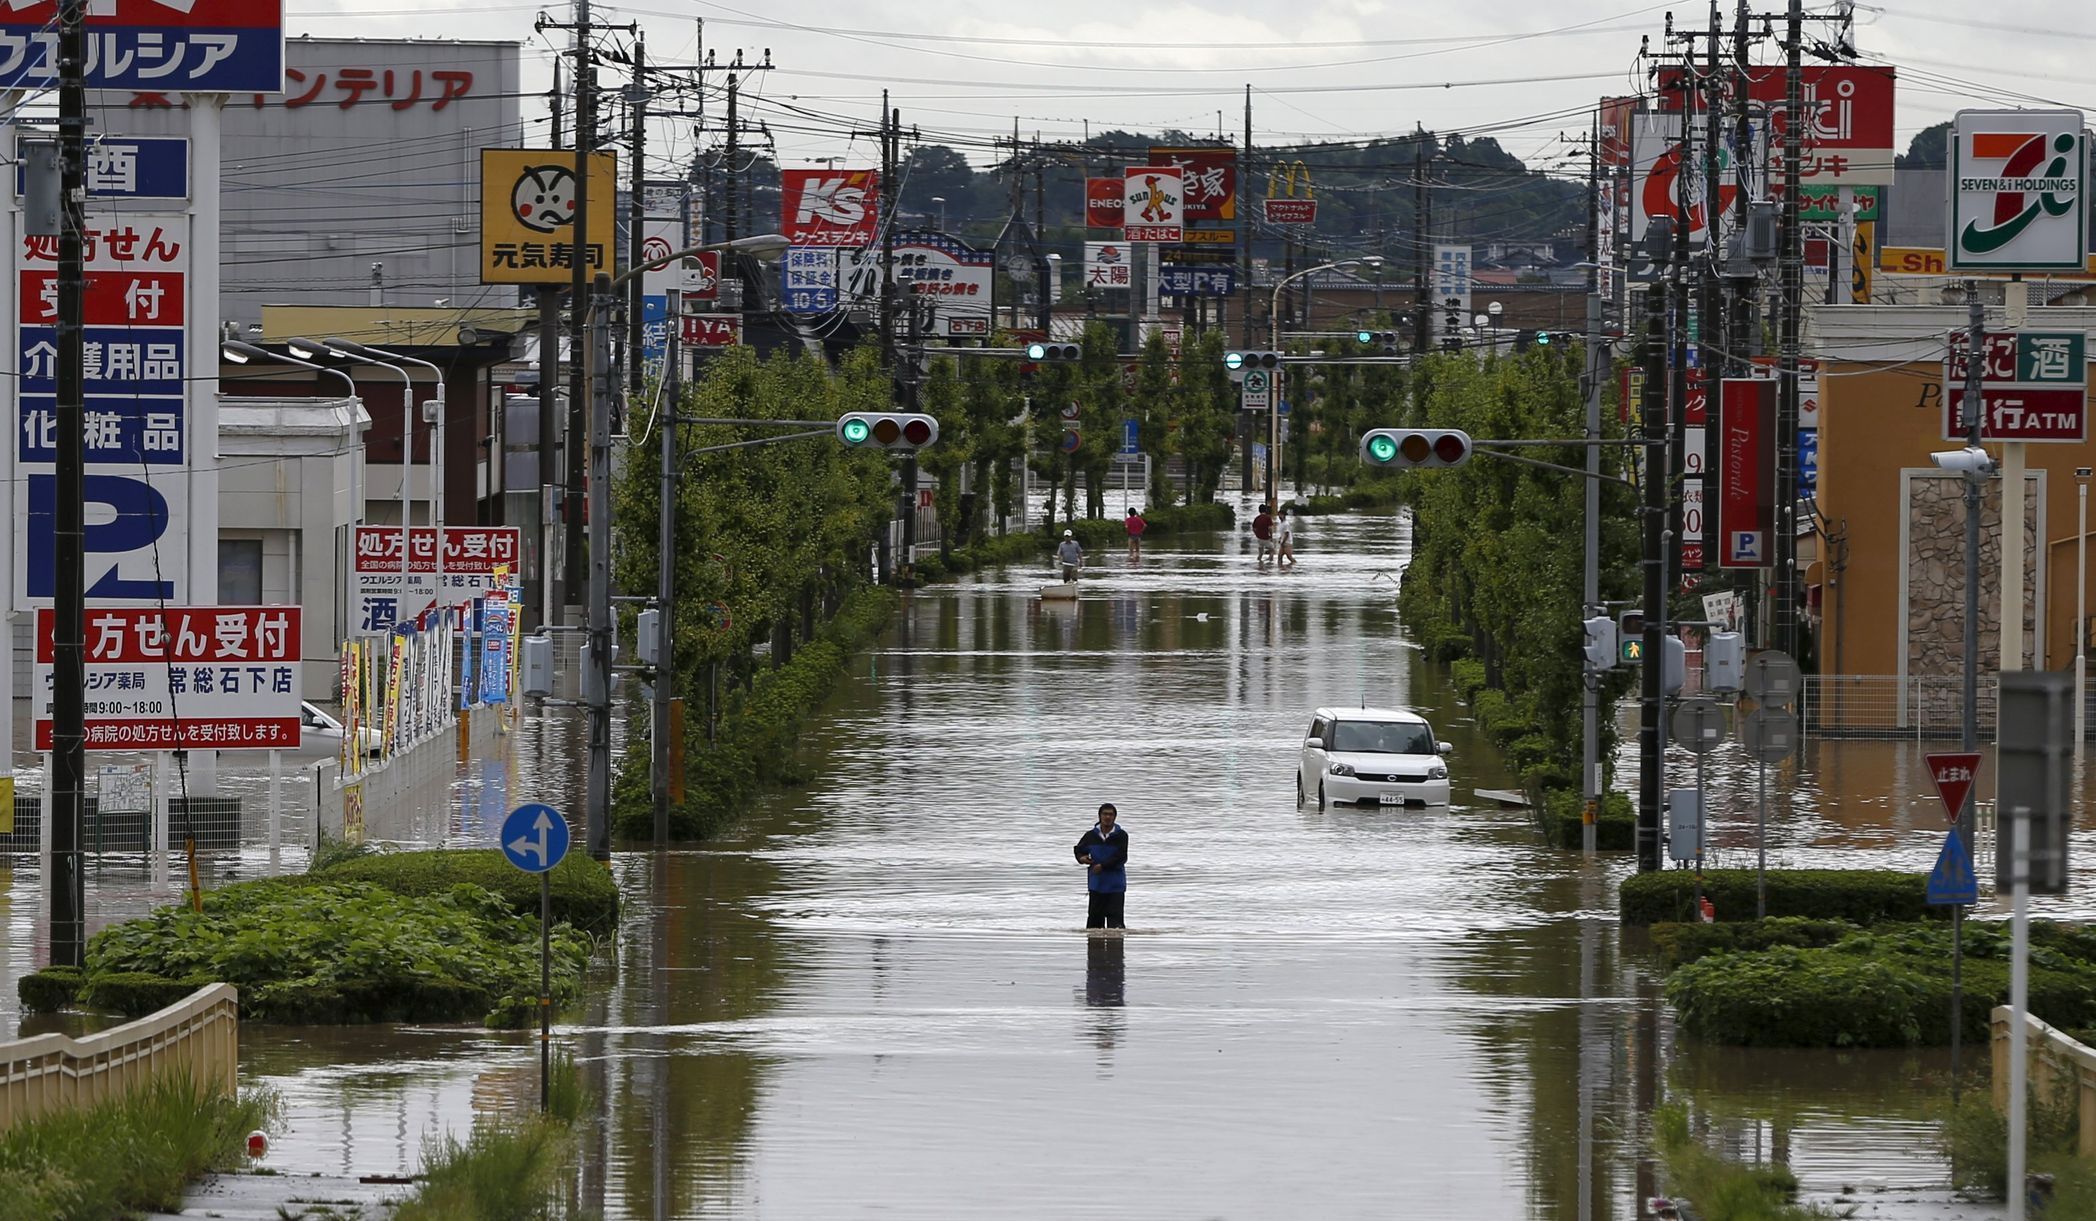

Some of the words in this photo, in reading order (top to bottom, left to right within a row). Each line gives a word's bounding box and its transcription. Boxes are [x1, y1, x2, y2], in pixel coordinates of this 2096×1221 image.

[2015, 178, 2076, 192] HOLDINGS
[1089, 199, 1125, 208] ENEO
[493, 243, 604, 269] 元気寿司
[1088, 266, 1129, 285] 太陽
[2030, 337, 2072, 380] 酒
[25, 411, 179, 451] 化粧品
[361, 597, 398, 632] 酒
[51, 612, 289, 658] 方せん受付
[169, 666, 293, 693] 常総石下店
[1937, 767, 1971, 782] 止まれ
